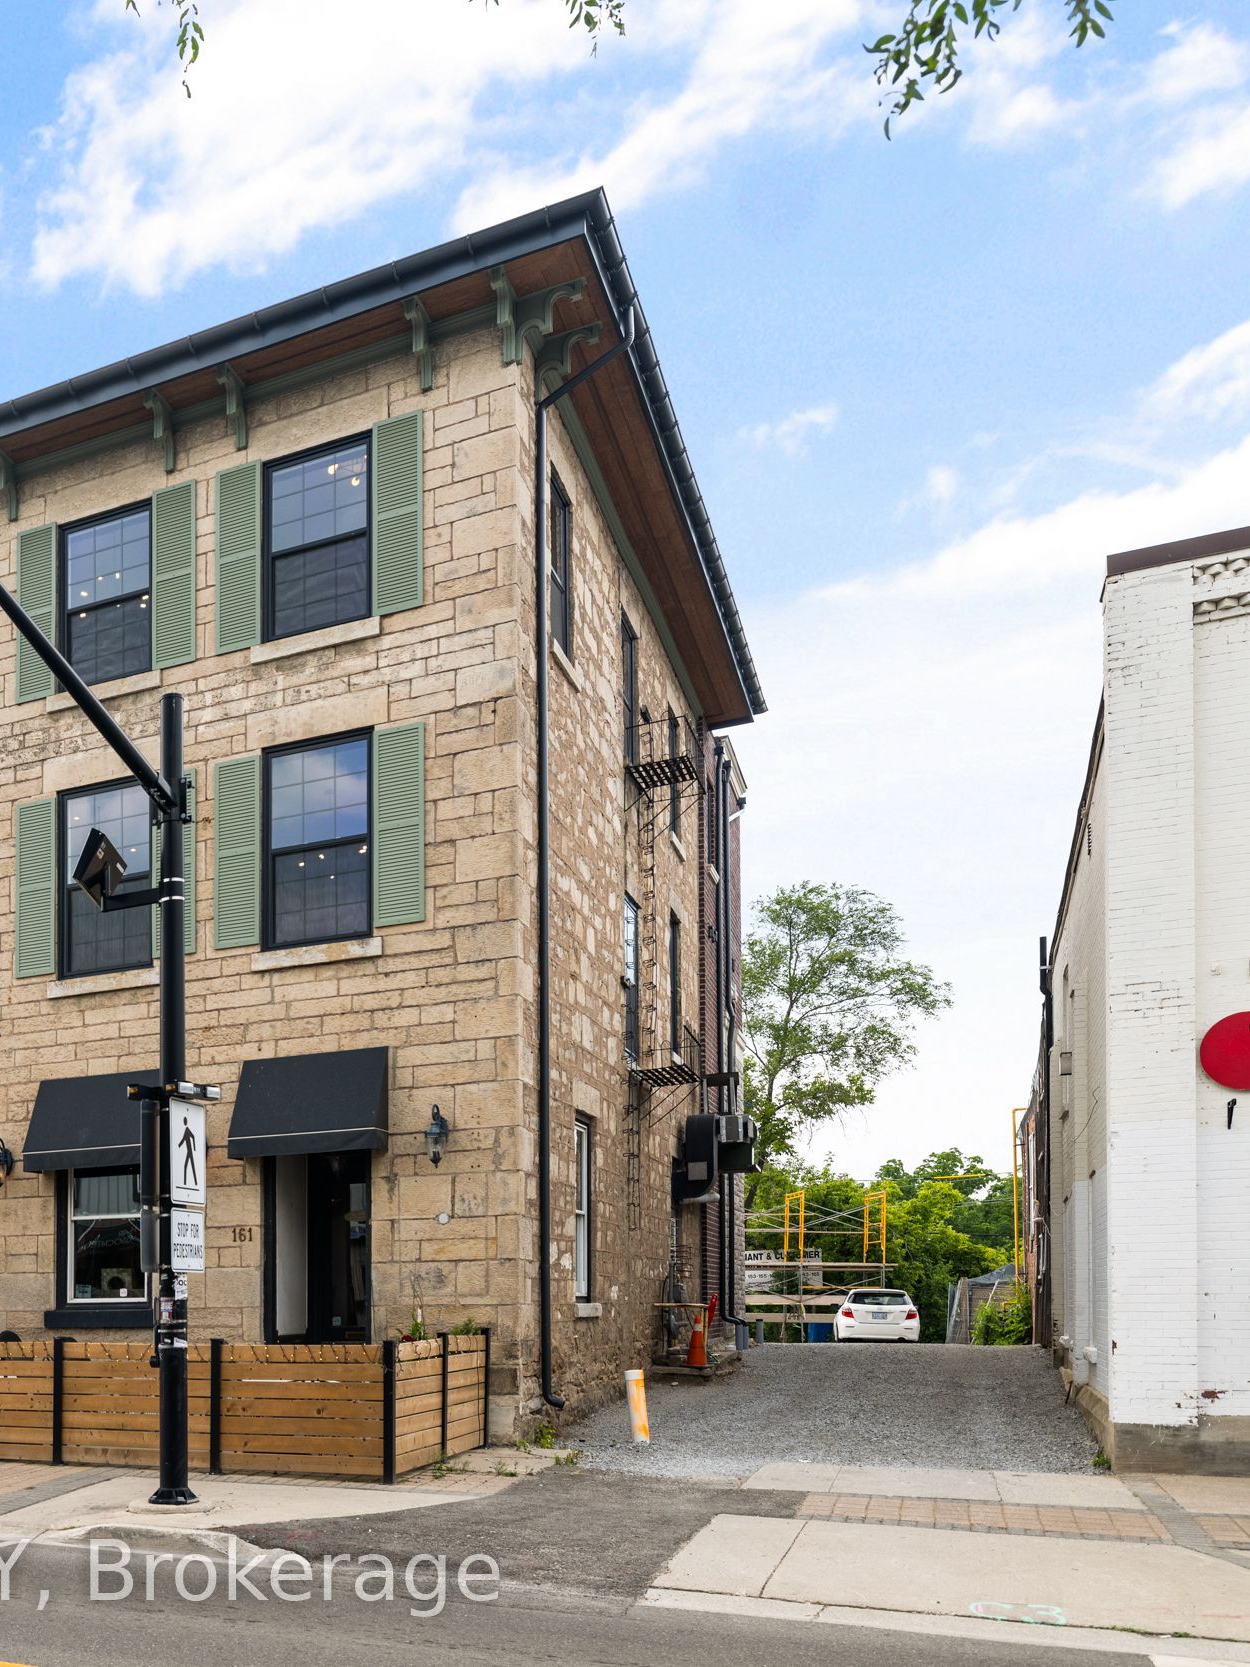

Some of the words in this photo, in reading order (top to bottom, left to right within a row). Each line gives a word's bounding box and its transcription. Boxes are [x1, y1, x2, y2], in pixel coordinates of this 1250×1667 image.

[177, 1222, 189, 1238] STOP
[190, 1223, 200, 1239] FOR
[232, 1227, 253, 1243] 161
[173, 1242, 203, 1260] PEDESTRIANS
